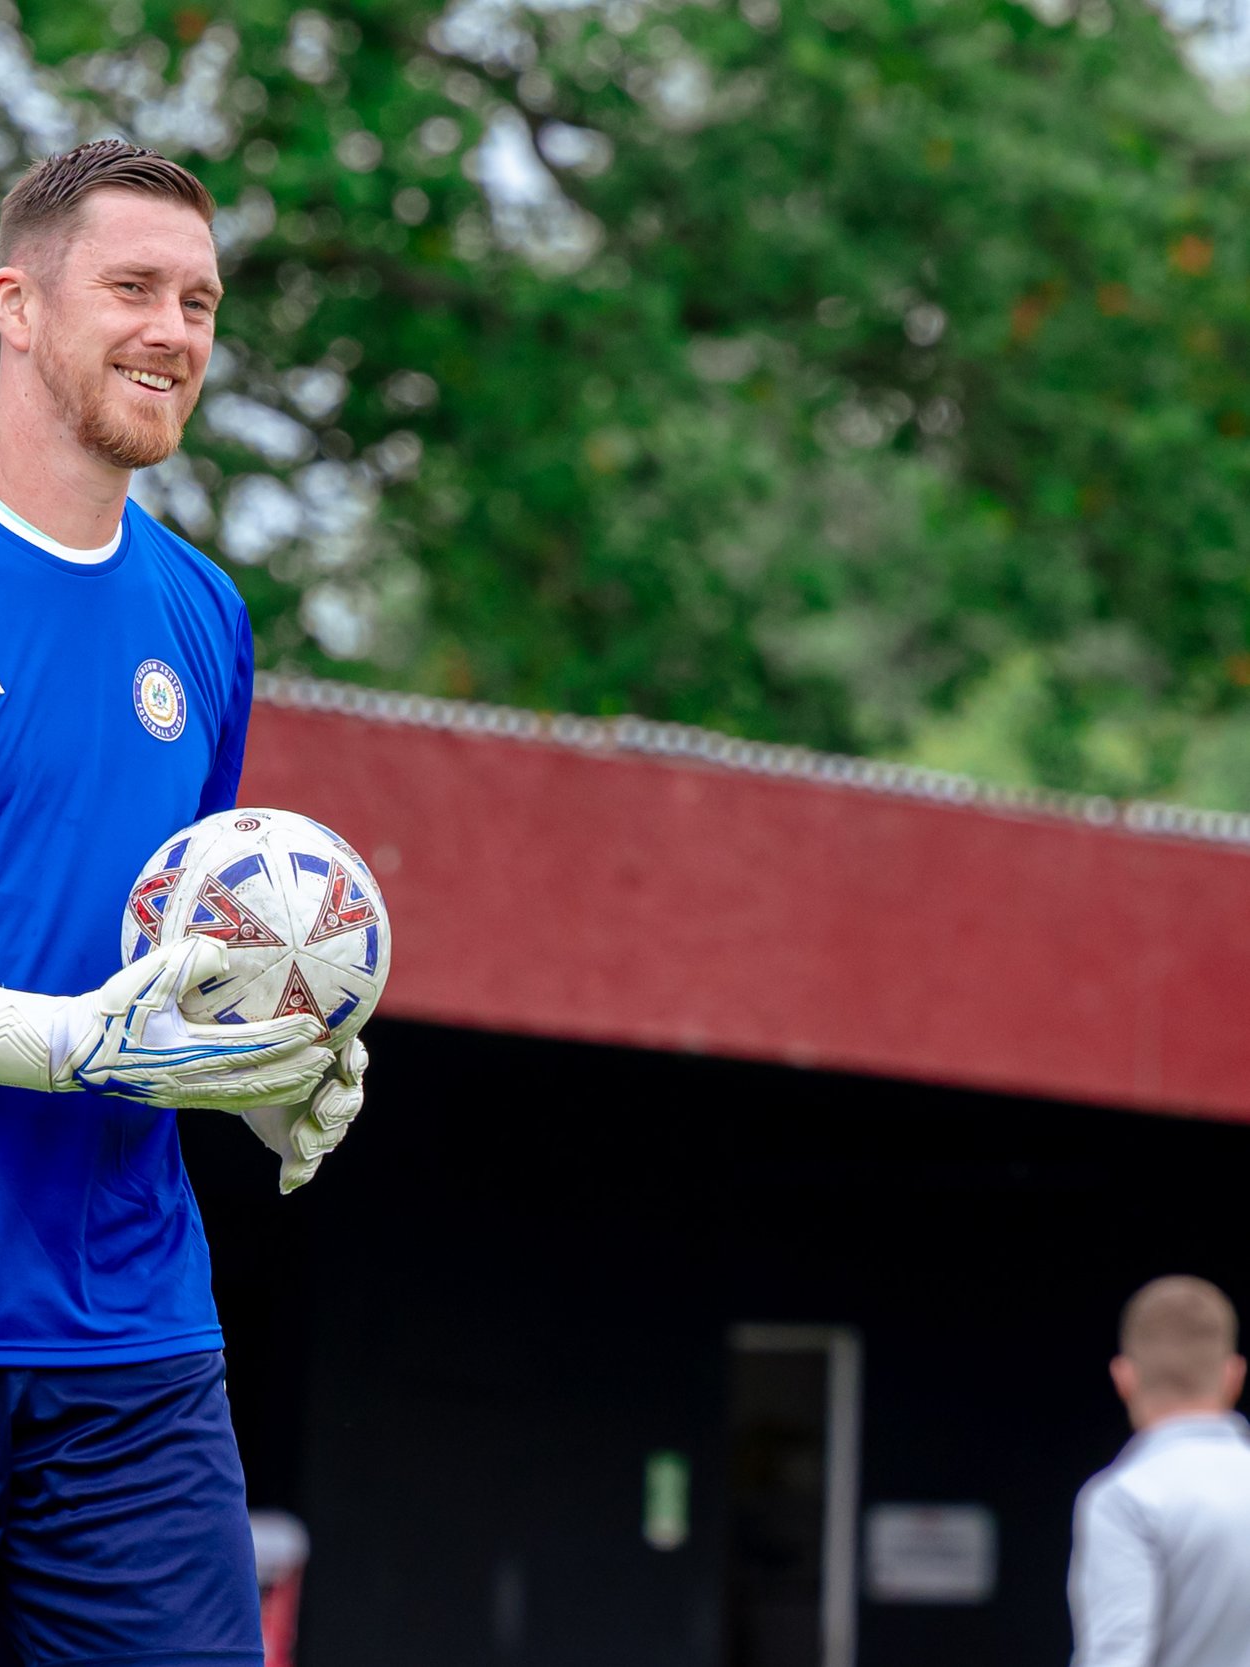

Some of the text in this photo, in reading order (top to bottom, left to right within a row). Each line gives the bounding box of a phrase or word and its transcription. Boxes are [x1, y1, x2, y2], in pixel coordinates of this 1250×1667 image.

[135, 661, 183, 700] CURZON ASHTON
[137, 702, 183, 737] FOOTBALL CLUB
